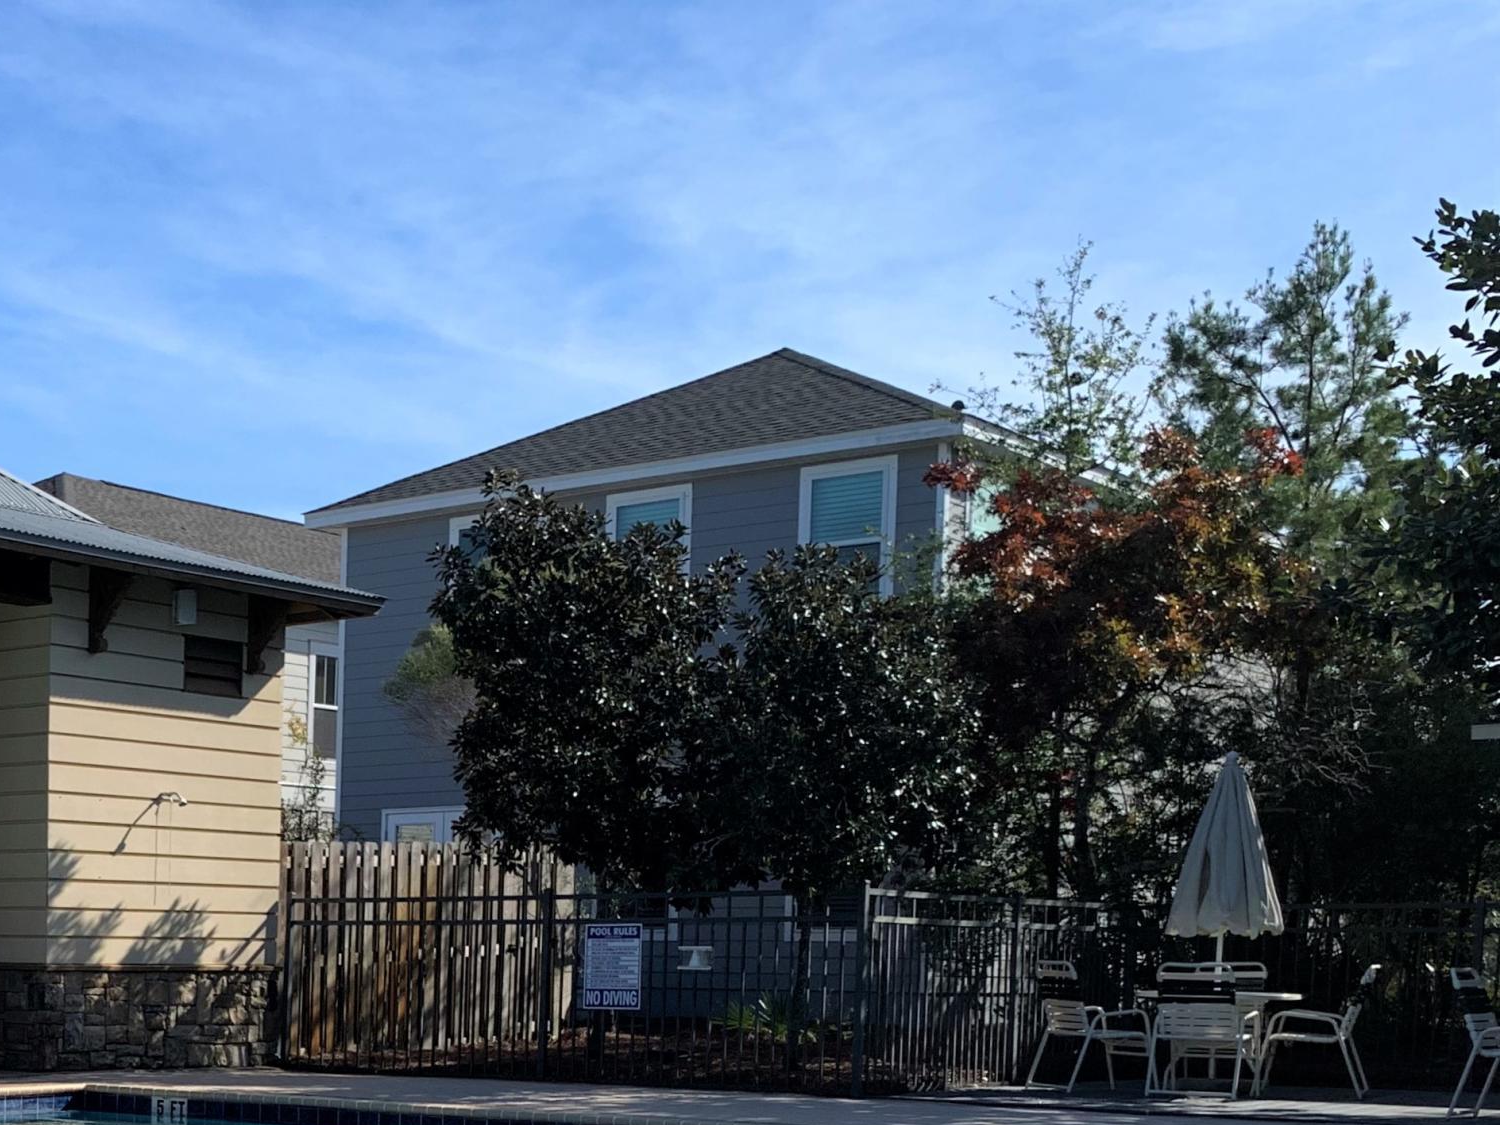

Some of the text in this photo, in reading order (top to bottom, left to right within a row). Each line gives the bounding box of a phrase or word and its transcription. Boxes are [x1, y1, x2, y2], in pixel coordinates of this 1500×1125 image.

[590, 927, 637, 936] POOL RULES
[586, 990, 637, 1006] NO DIVING
[157, 1099, 165, 1116] 5
